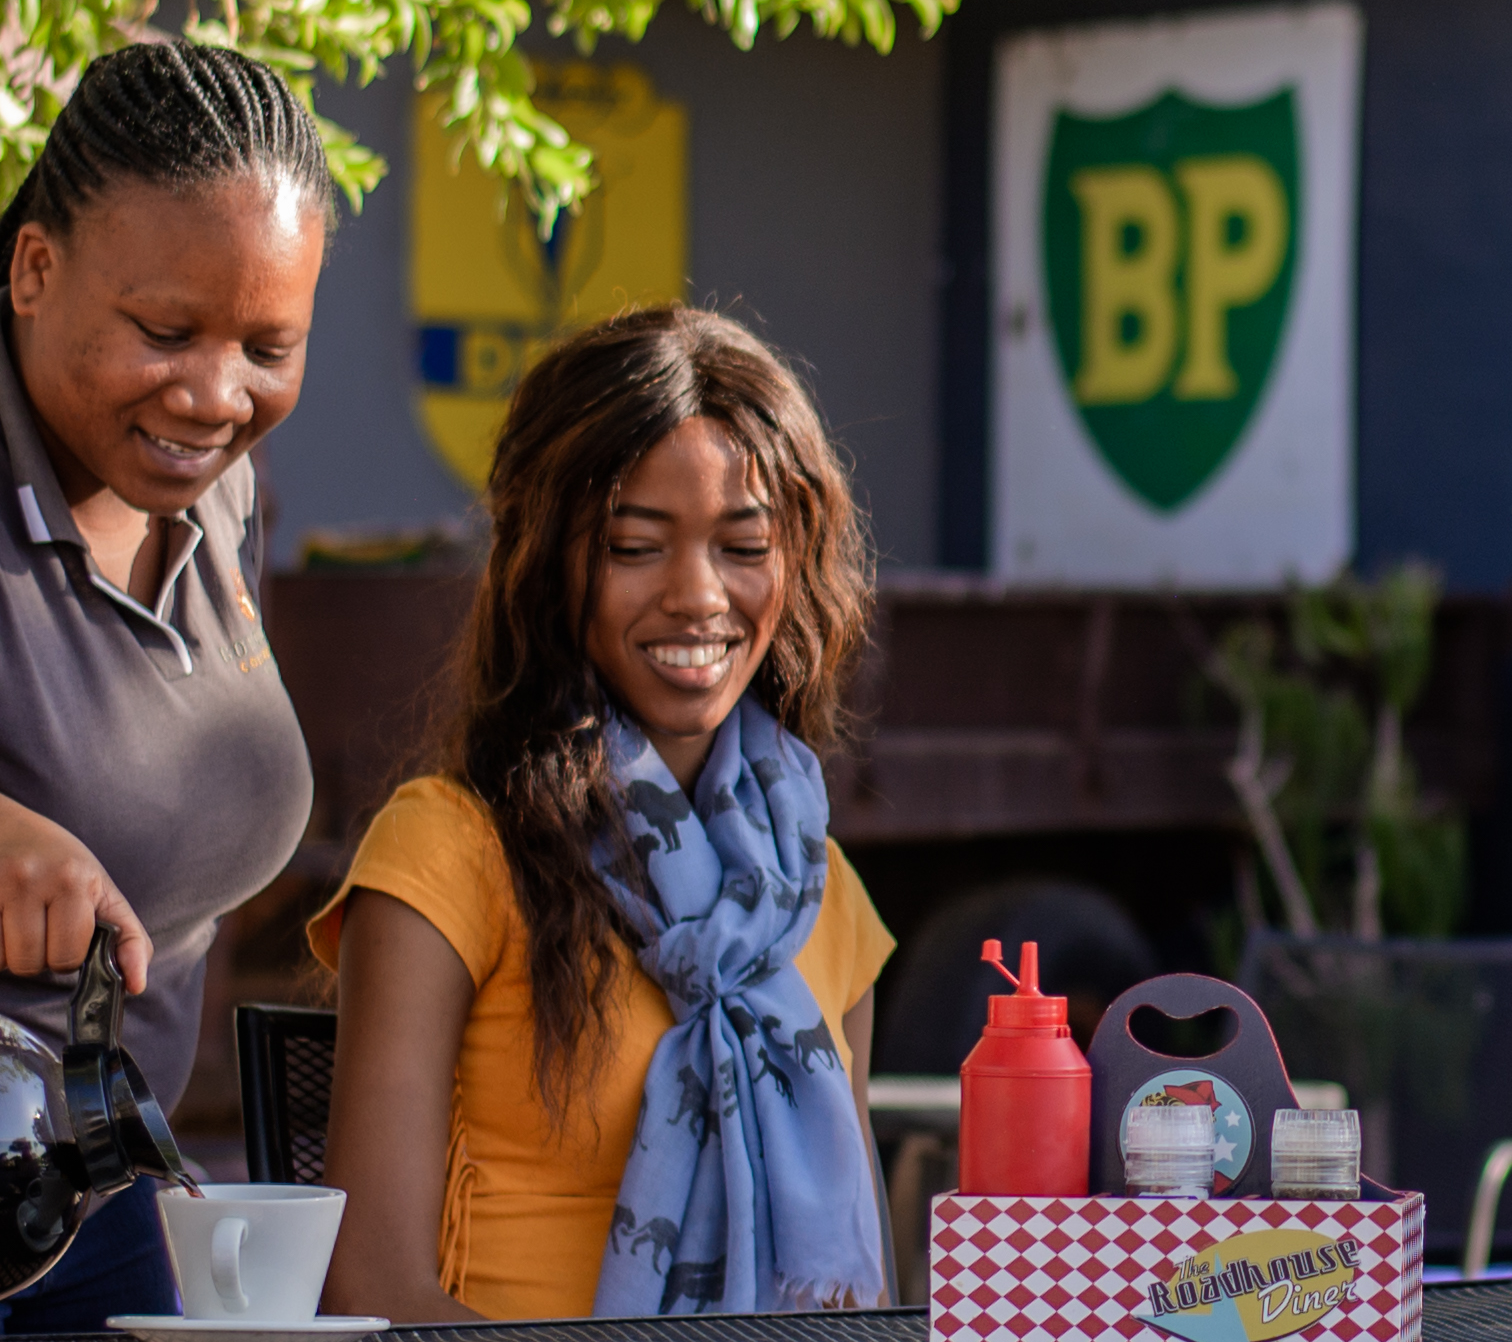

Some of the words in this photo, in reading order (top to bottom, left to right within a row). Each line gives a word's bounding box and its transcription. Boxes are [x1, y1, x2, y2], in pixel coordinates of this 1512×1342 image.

[1070, 153, 1288, 405] BP
[1148, 1239, 1361, 1317] Roadhouse
[1173, 1256, 1210, 1281] The
[1257, 1279, 1358, 1324] Diner
